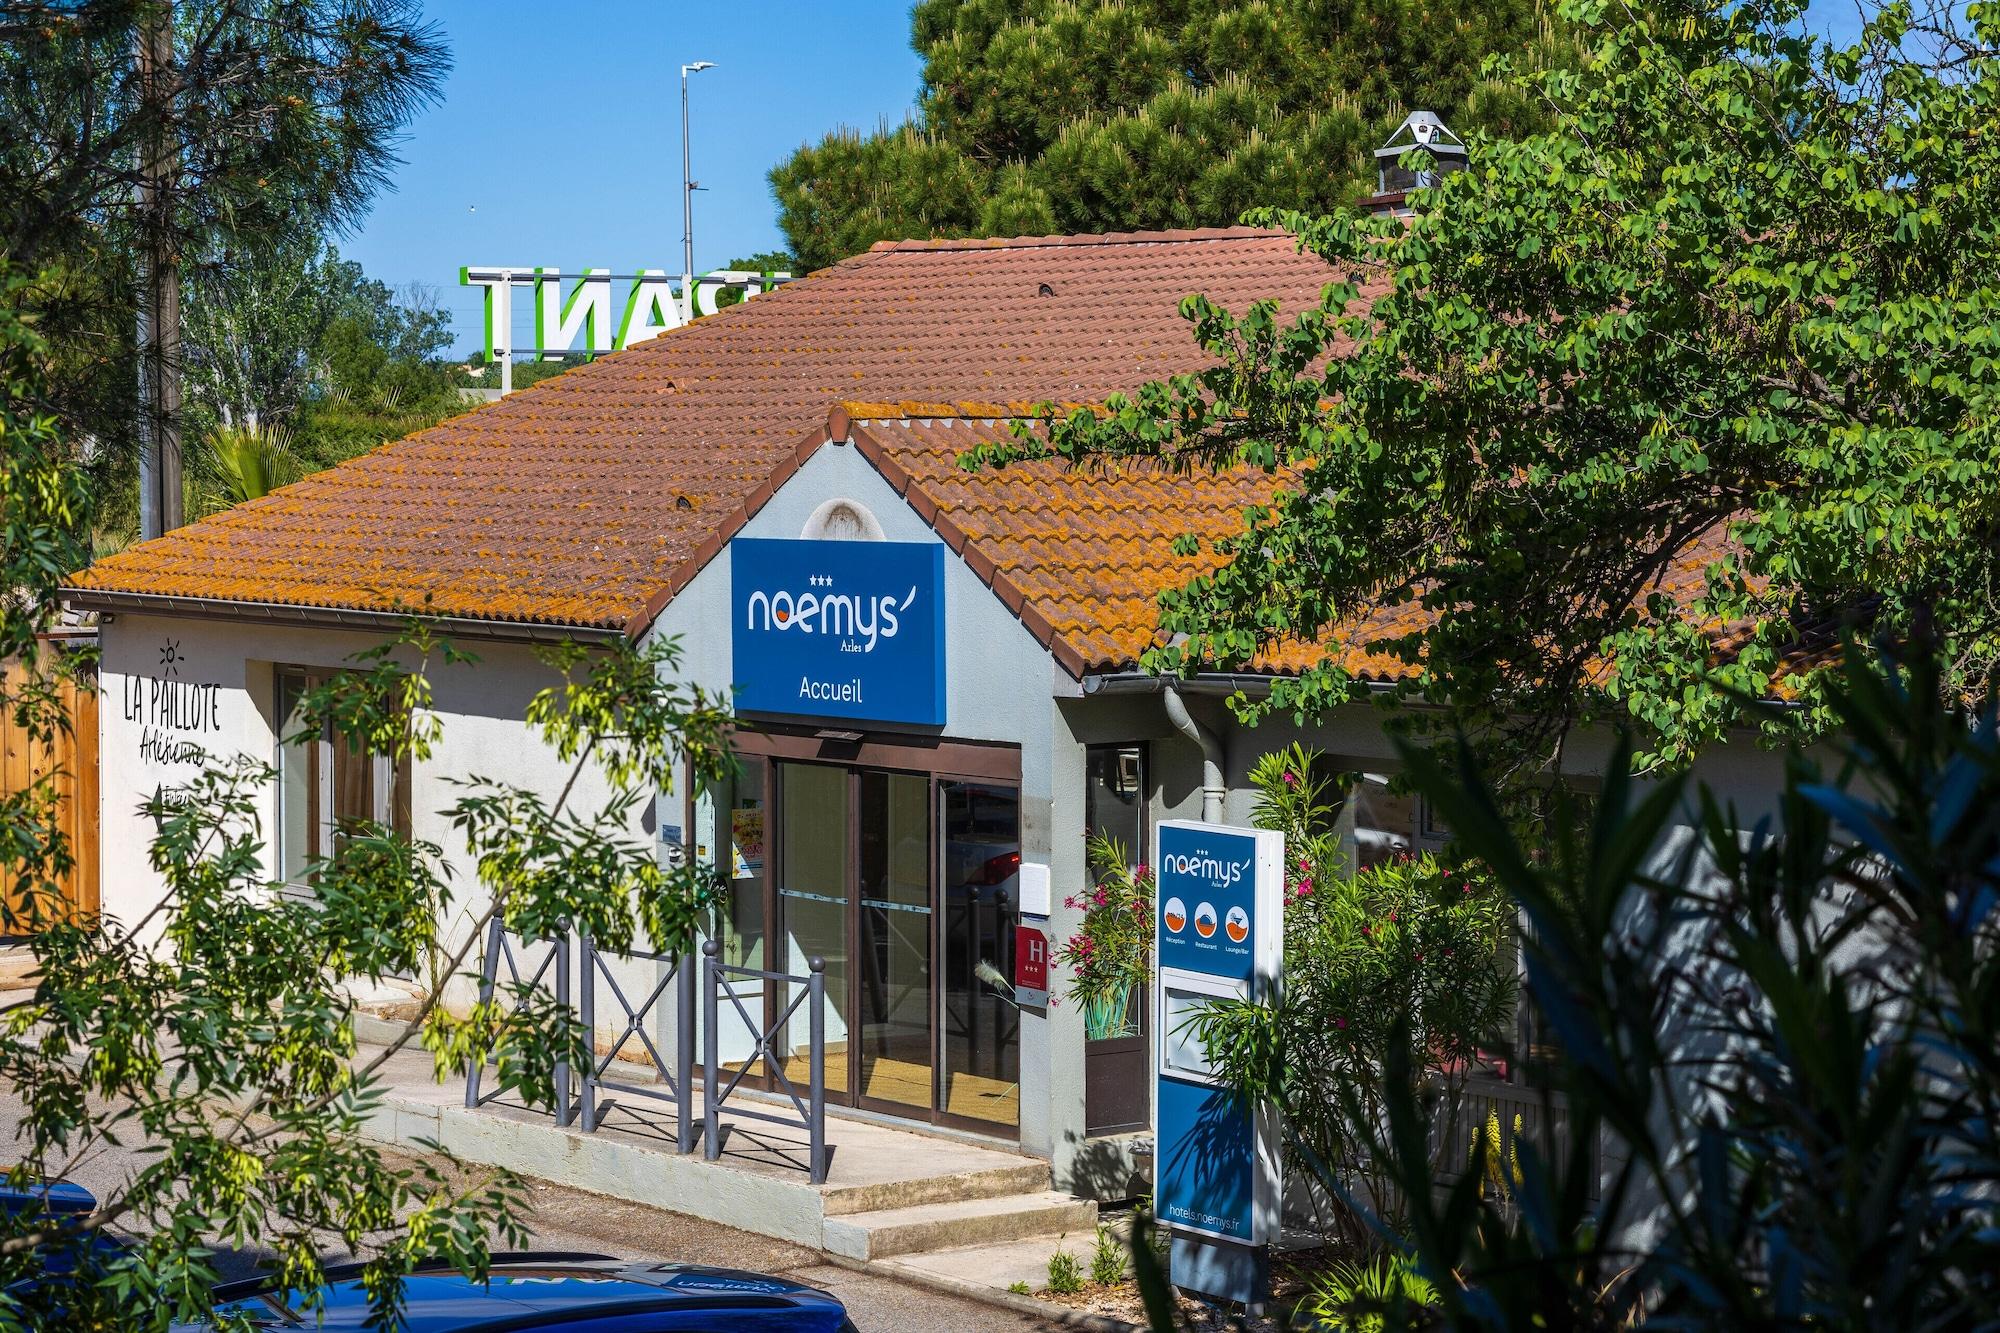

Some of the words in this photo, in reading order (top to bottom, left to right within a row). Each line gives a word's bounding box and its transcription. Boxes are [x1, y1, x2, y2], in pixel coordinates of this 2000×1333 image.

[840, 639, 862, 653] Arles
[799, 676, 863, 703] Accueil
[124, 672, 143, 725] LA
[151, 676, 222, 733] PAILLOTE
[1029, 940, 1044, 963] H
[1195, 942, 1217, 950] Restaurant
[1169, 1204, 1240, 1232] hotels.noemys.fr
